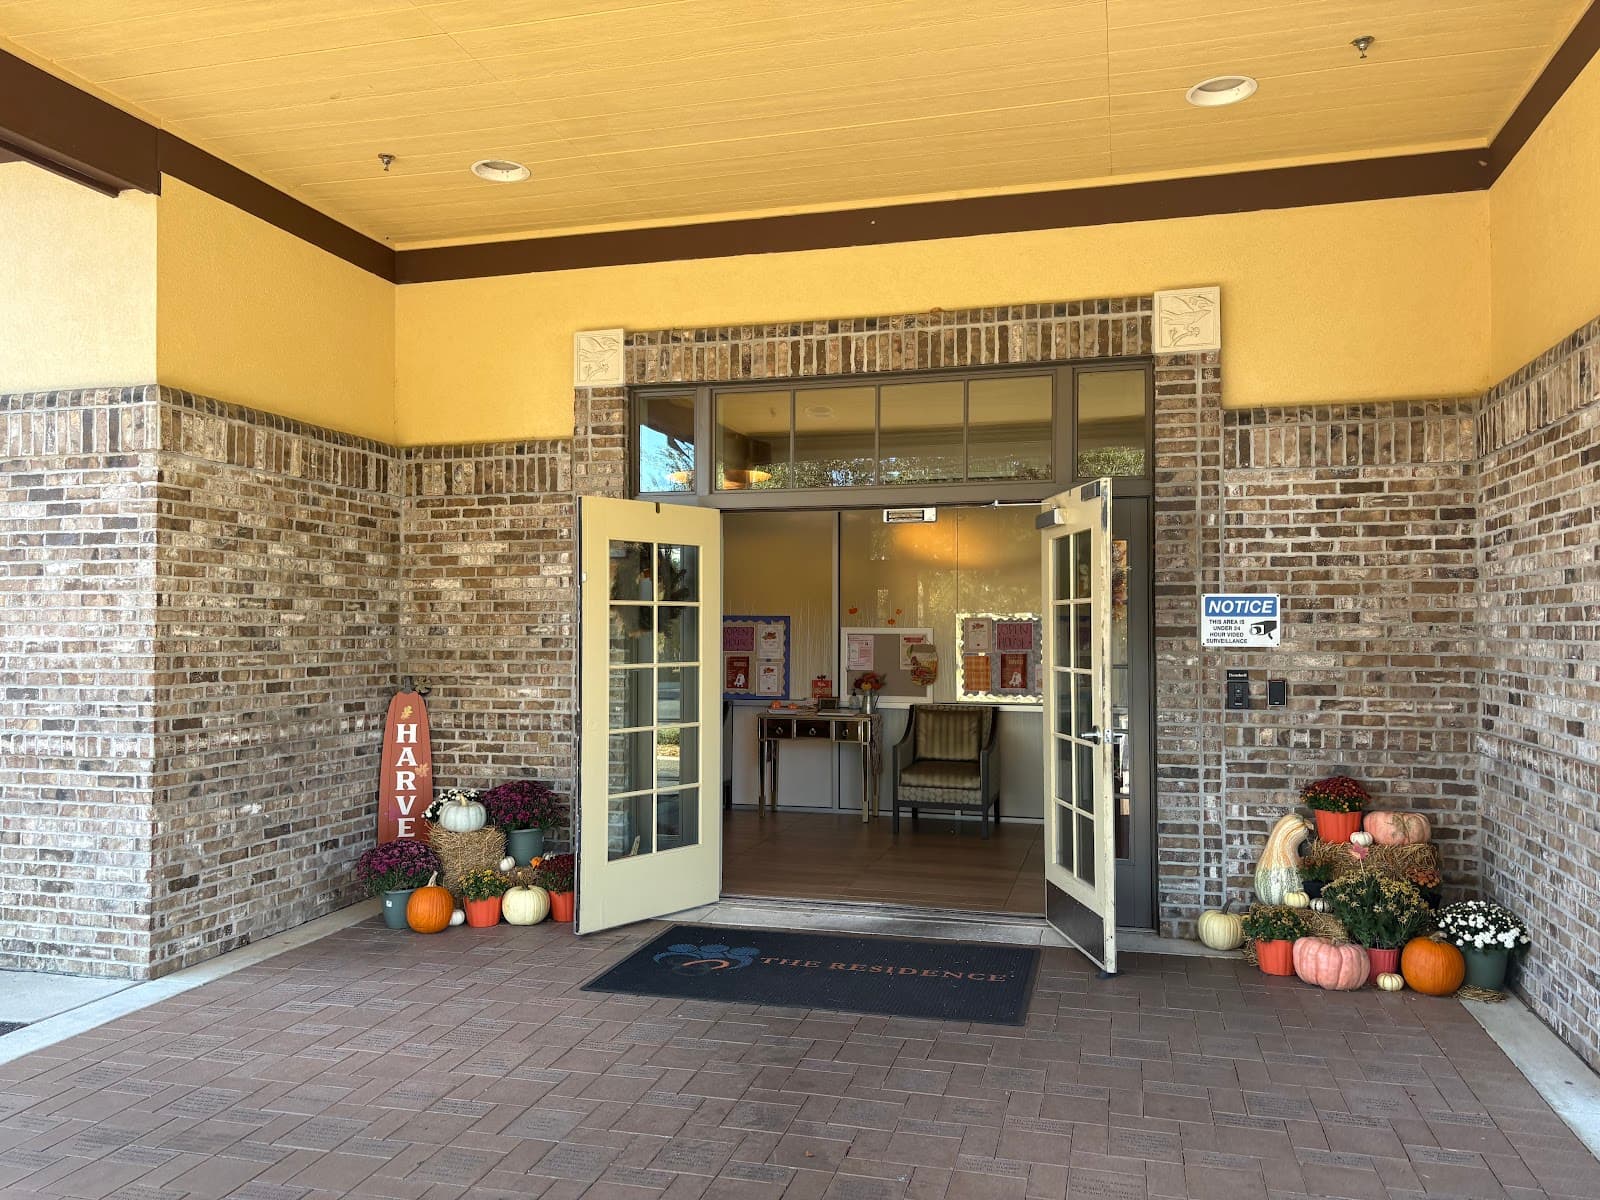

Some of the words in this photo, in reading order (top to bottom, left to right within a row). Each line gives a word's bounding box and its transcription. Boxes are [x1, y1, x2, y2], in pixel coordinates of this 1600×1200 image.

[1208, 600, 1274, 614] NOTICE
[395, 723, 418, 837] HARVE
[760, 957, 822, 968] THE
[828, 961, 1007, 982] RESIDENCE
